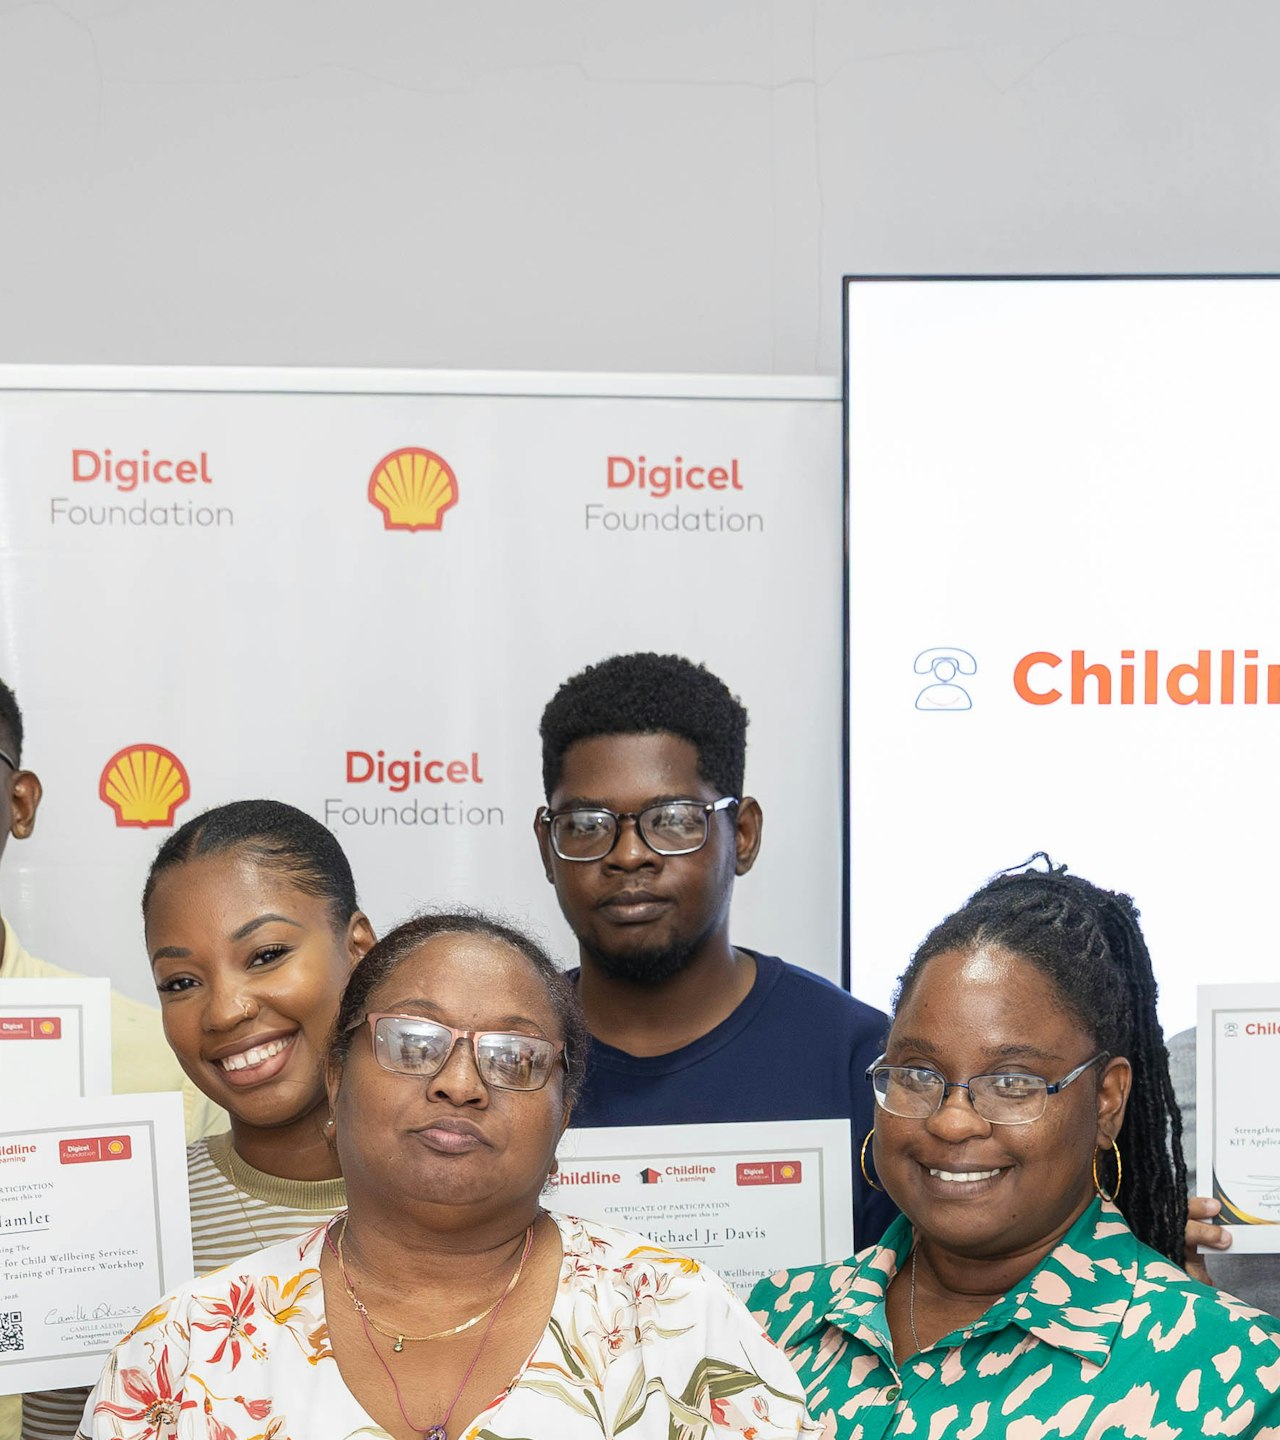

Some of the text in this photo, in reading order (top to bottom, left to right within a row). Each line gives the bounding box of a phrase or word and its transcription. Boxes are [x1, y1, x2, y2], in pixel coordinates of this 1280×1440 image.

[72, 449, 212, 492] Digicel
[607, 455, 743, 498] Digicel
[51, 498, 234, 526] Foundation
[585, 504, 764, 532] Foundation
[346, 750, 483, 793] Digicel
[324, 799, 504, 826] Foundation
[665, 1165, 716, 1176] Childline
[675, 1175, 706, 1183] Learning
[704, 1228, 718, 1244] Jr
[725, 1226, 766, 1239] Davis
